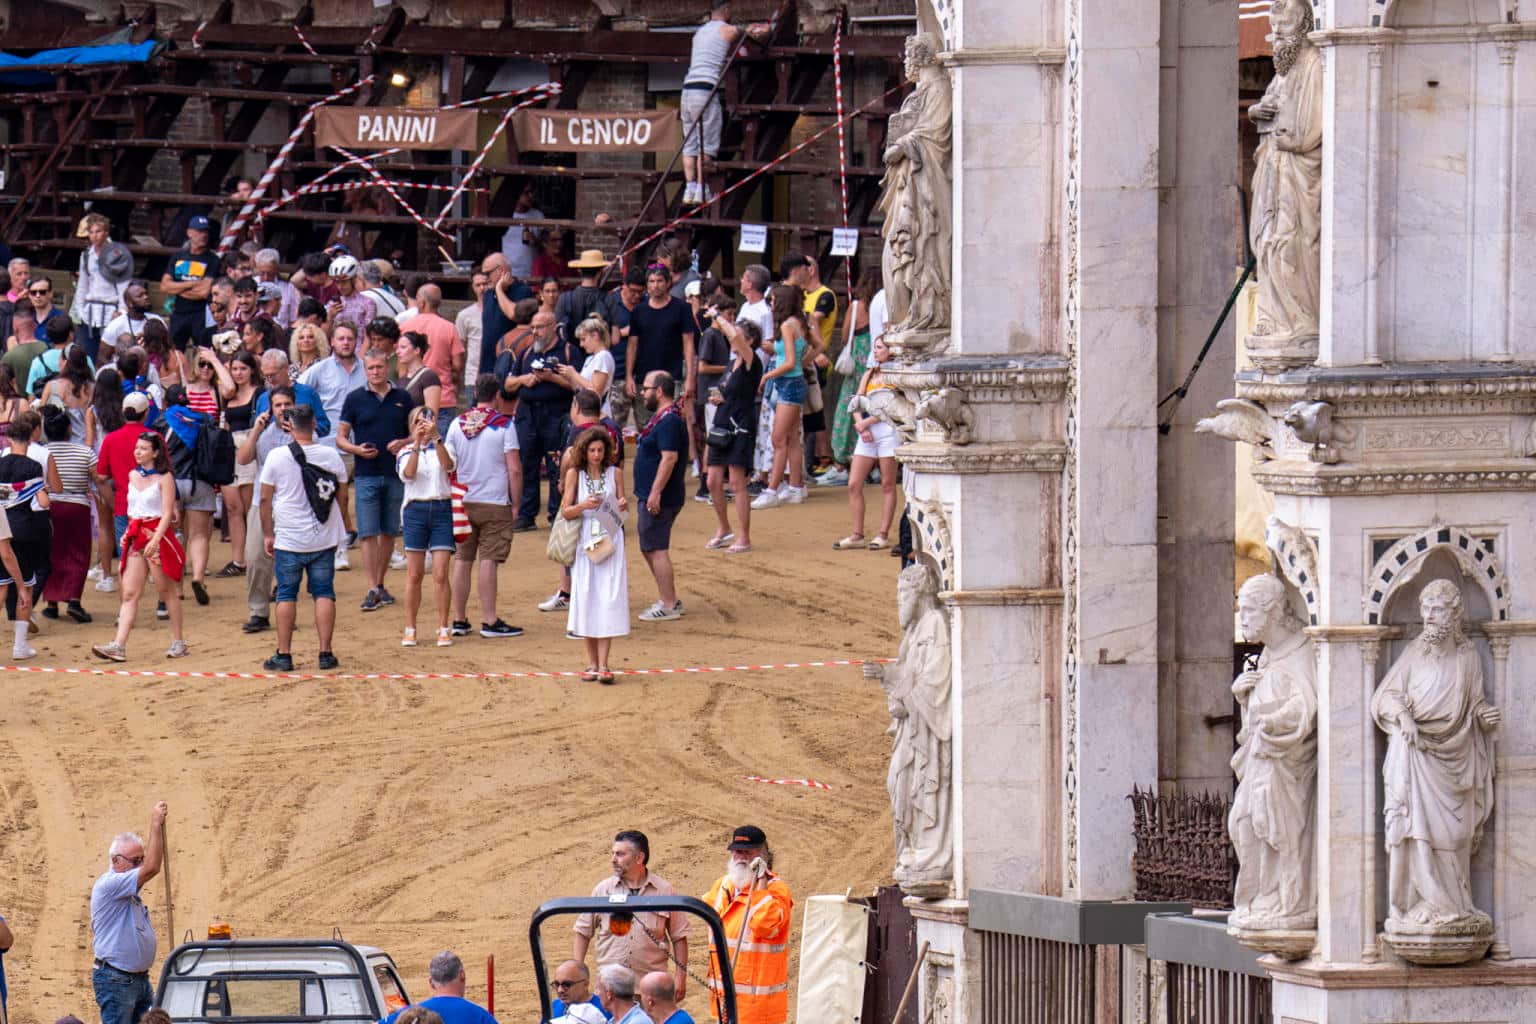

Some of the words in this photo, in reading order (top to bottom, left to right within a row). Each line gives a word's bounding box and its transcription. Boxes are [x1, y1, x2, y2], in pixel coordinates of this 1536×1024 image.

[357, 115, 437, 143] PANINI
[540, 117, 557, 143] IL
[567, 117, 652, 145] CENCIO
